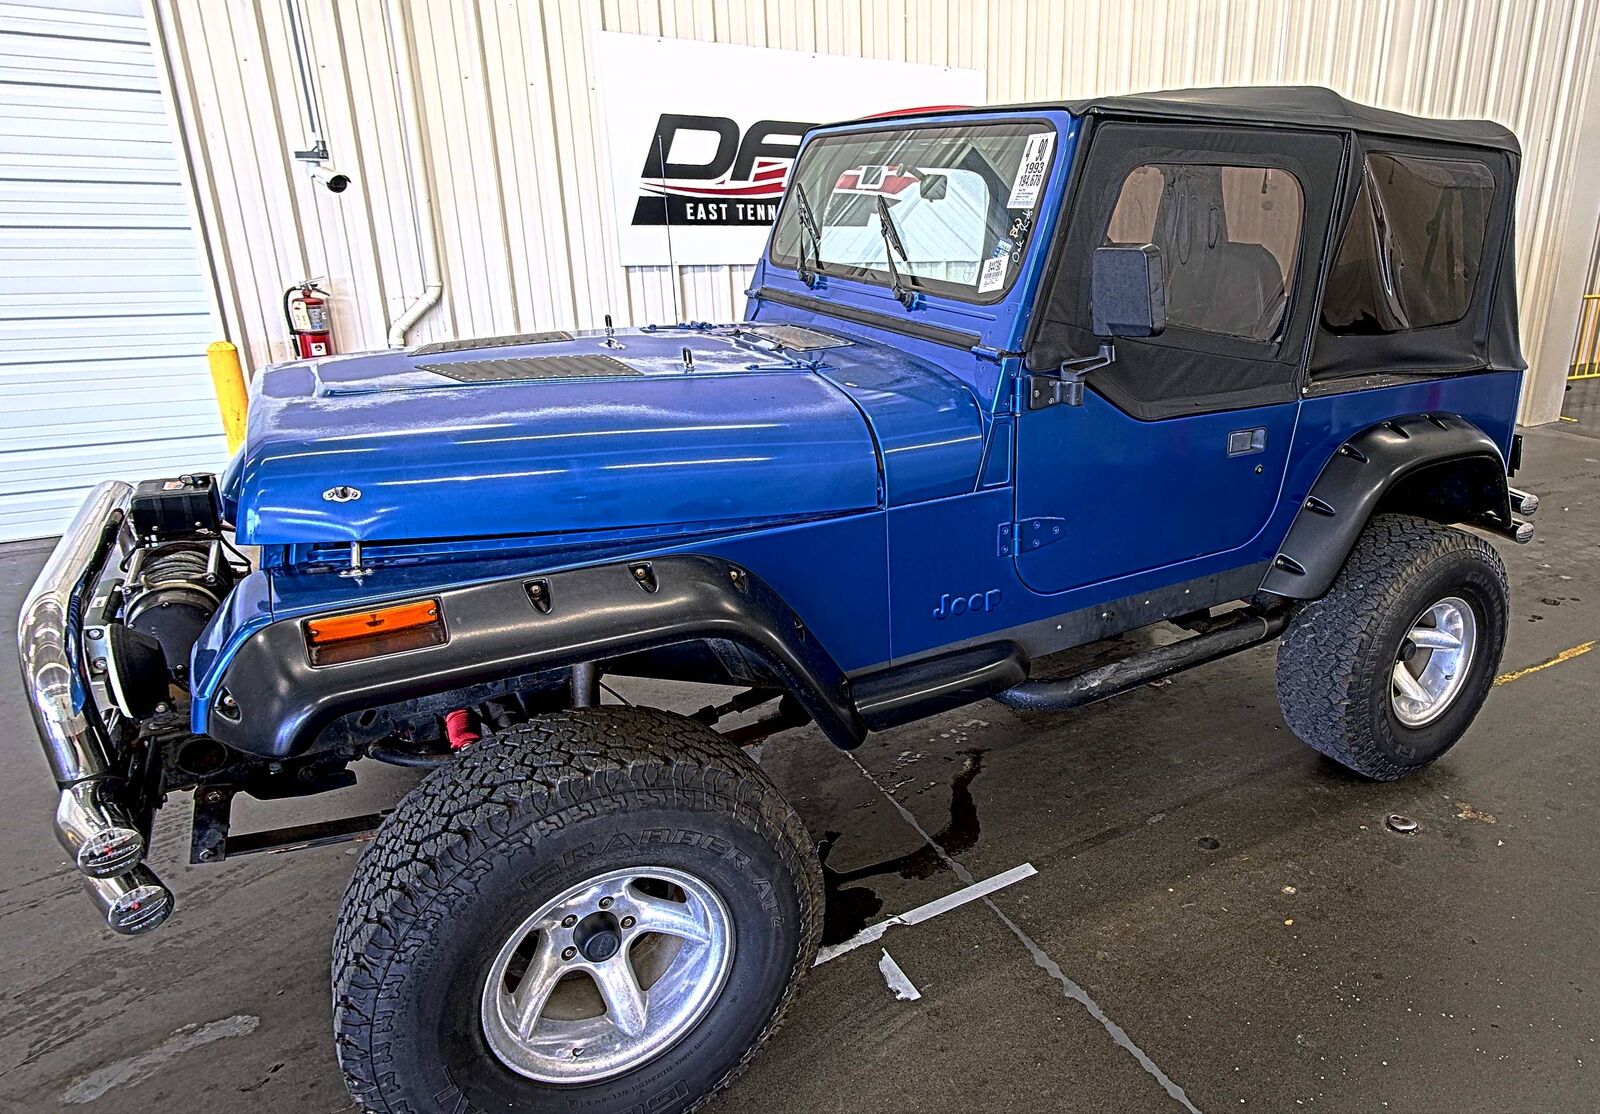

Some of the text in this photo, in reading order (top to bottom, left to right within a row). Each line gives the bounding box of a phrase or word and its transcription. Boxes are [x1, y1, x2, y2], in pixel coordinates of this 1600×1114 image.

[1024, 161, 1045, 174] 1993
[685, 203, 728, 221] EAST
[932, 588, 1002, 621] Jeep
[519, 828, 752, 890] GRABBER
